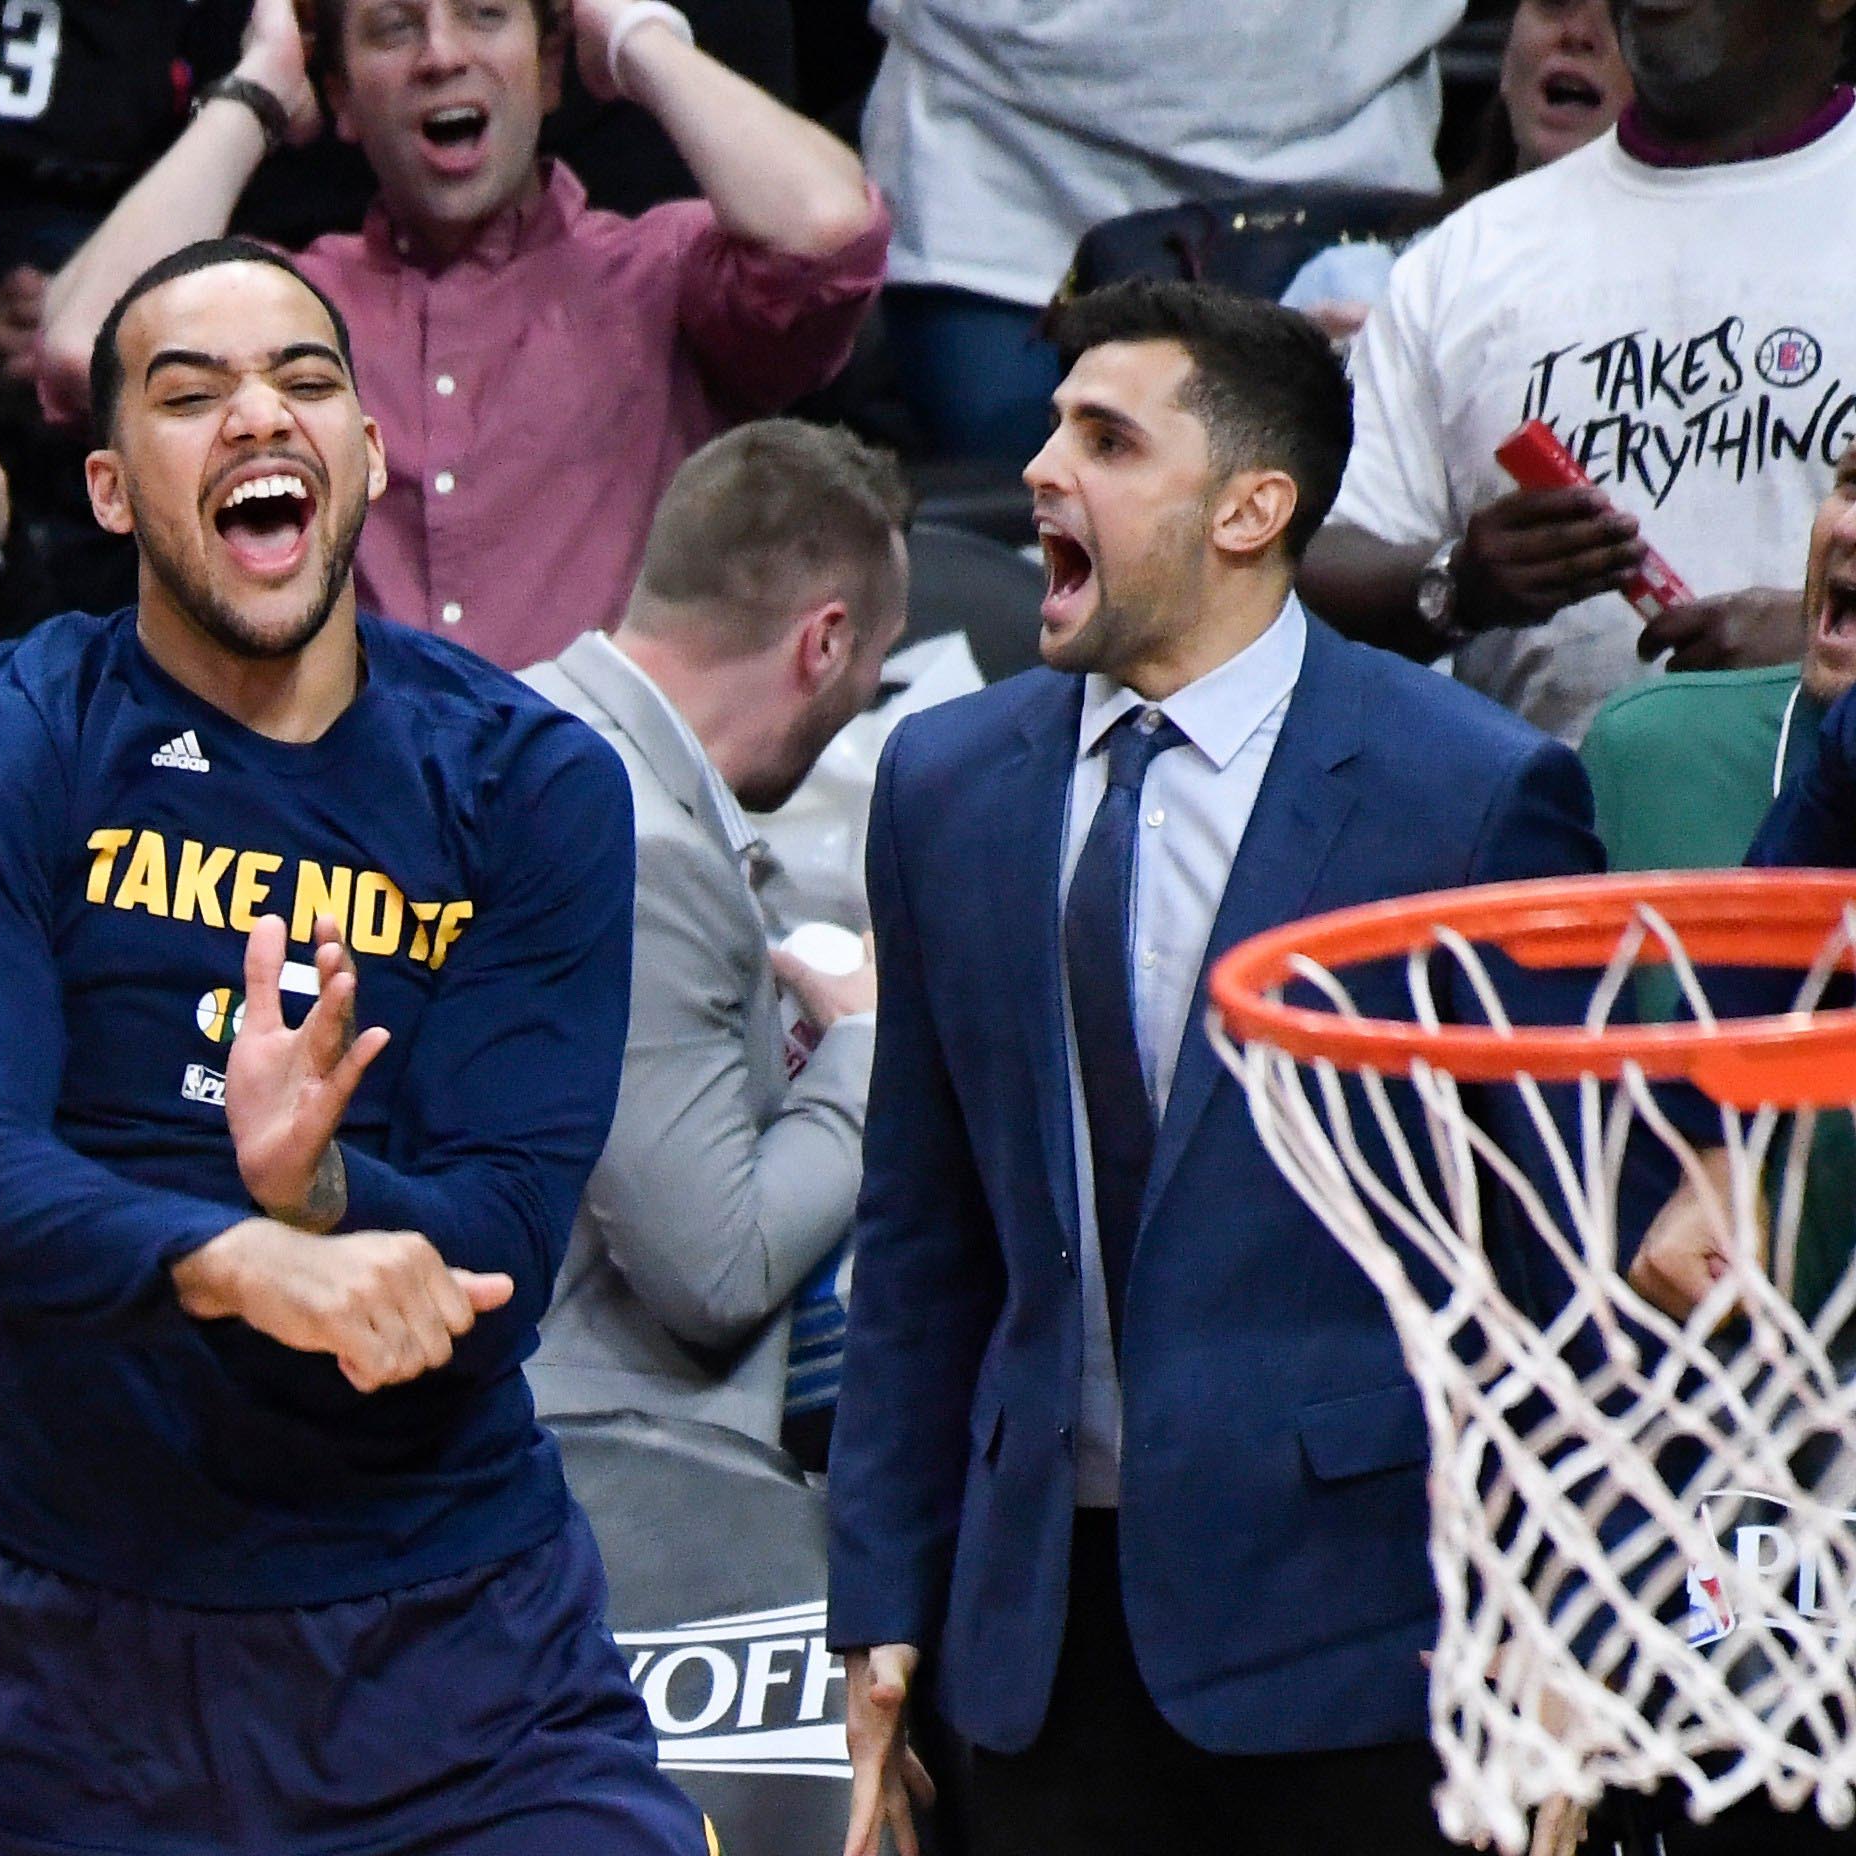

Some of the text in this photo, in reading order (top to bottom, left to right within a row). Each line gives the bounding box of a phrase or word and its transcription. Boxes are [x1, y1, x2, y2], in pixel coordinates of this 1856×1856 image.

[1580, 316, 1744, 409] TAKES
[1550, 379, 1856, 510] ERYTHING
[86, 828, 284, 934] TAKE
